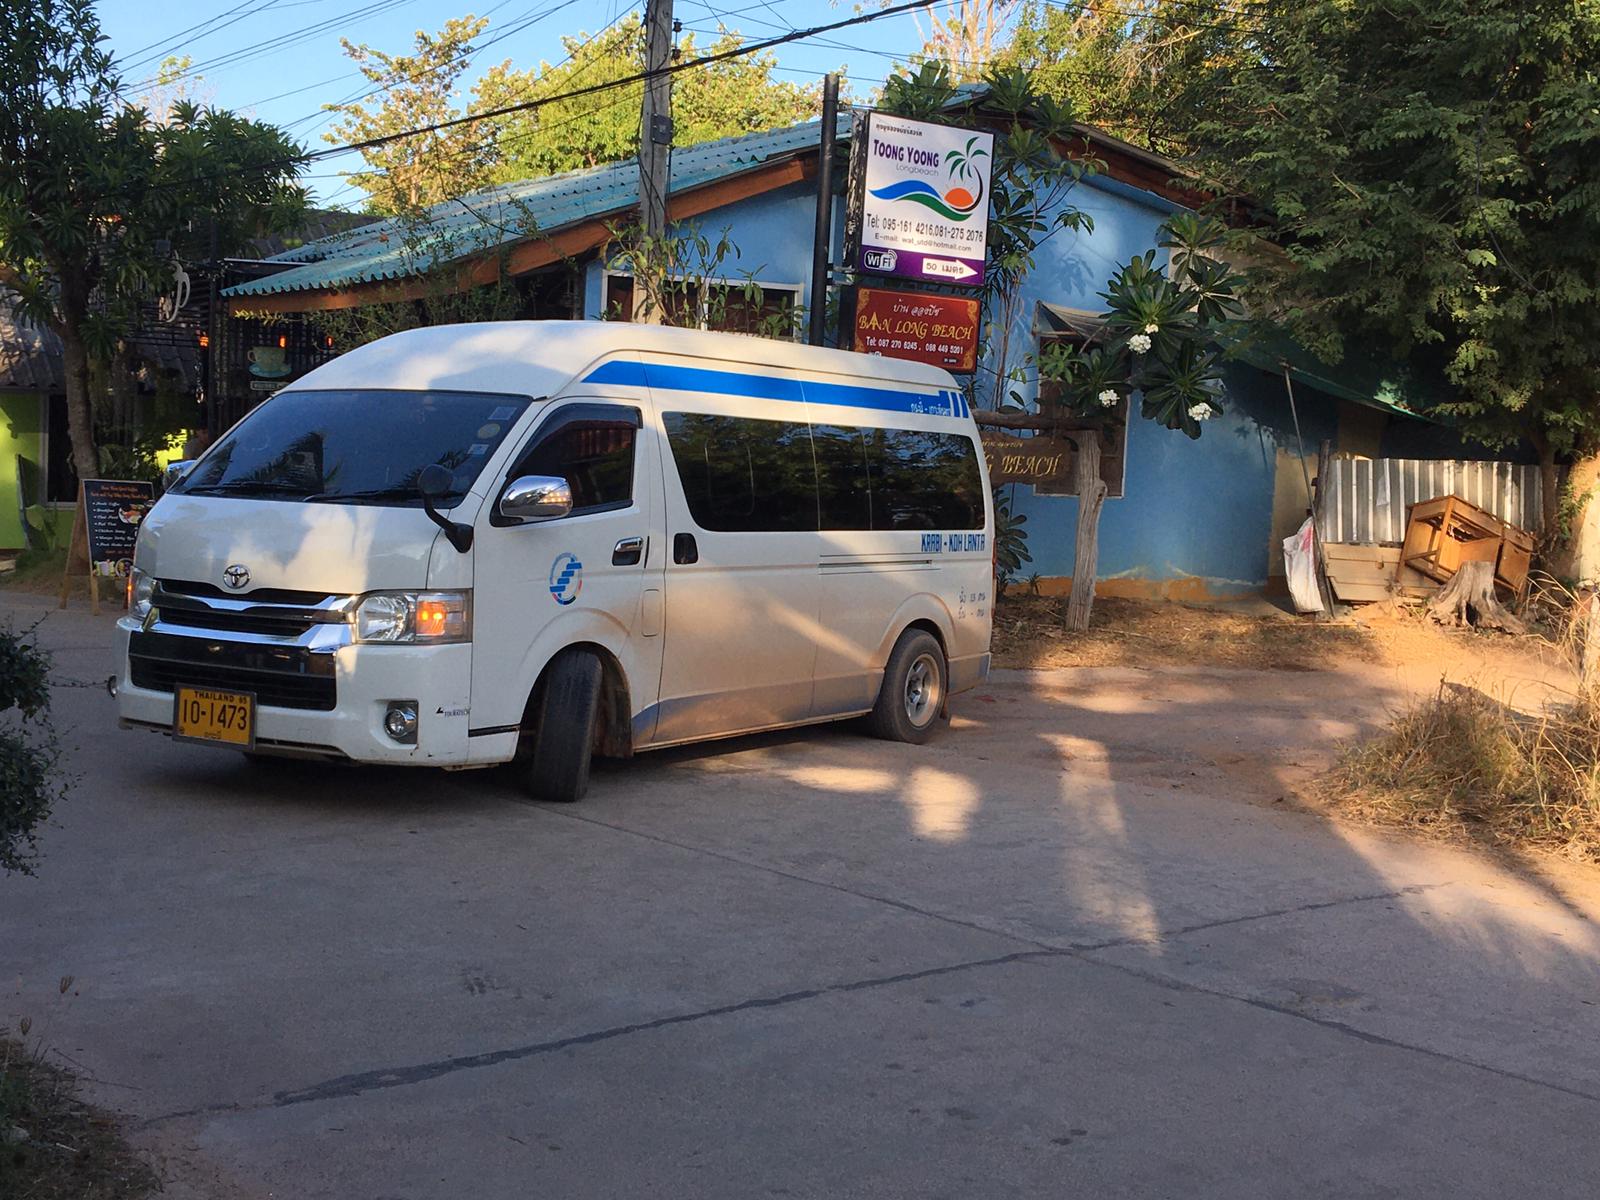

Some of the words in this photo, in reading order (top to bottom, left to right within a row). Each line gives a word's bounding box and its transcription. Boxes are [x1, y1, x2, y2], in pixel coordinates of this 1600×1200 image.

[873, 139, 904, 162] TOONG
[907, 146, 939, 167] YOONG
[896, 163, 939, 176] Longbeach
[867, 213, 879, 229] Tel:
[882, 218, 912, 233] 095-161
[966, 229, 984, 242] 2076
[926, 263, 937, 271] 50
[895, 320, 928, 340] LONG
[931, 324, 973, 340] BEACH
[891, 339, 902, 349] 270
[1001, 453, 1062, 477] BEACH
[921, 534, 942, 552] KRABI
[949, 534, 963, 552] KOH
[964, 534, 985, 552] LANTA
[194, 690, 234, 702] THAILAND
[183, 699, 248, 730] 10-1473
